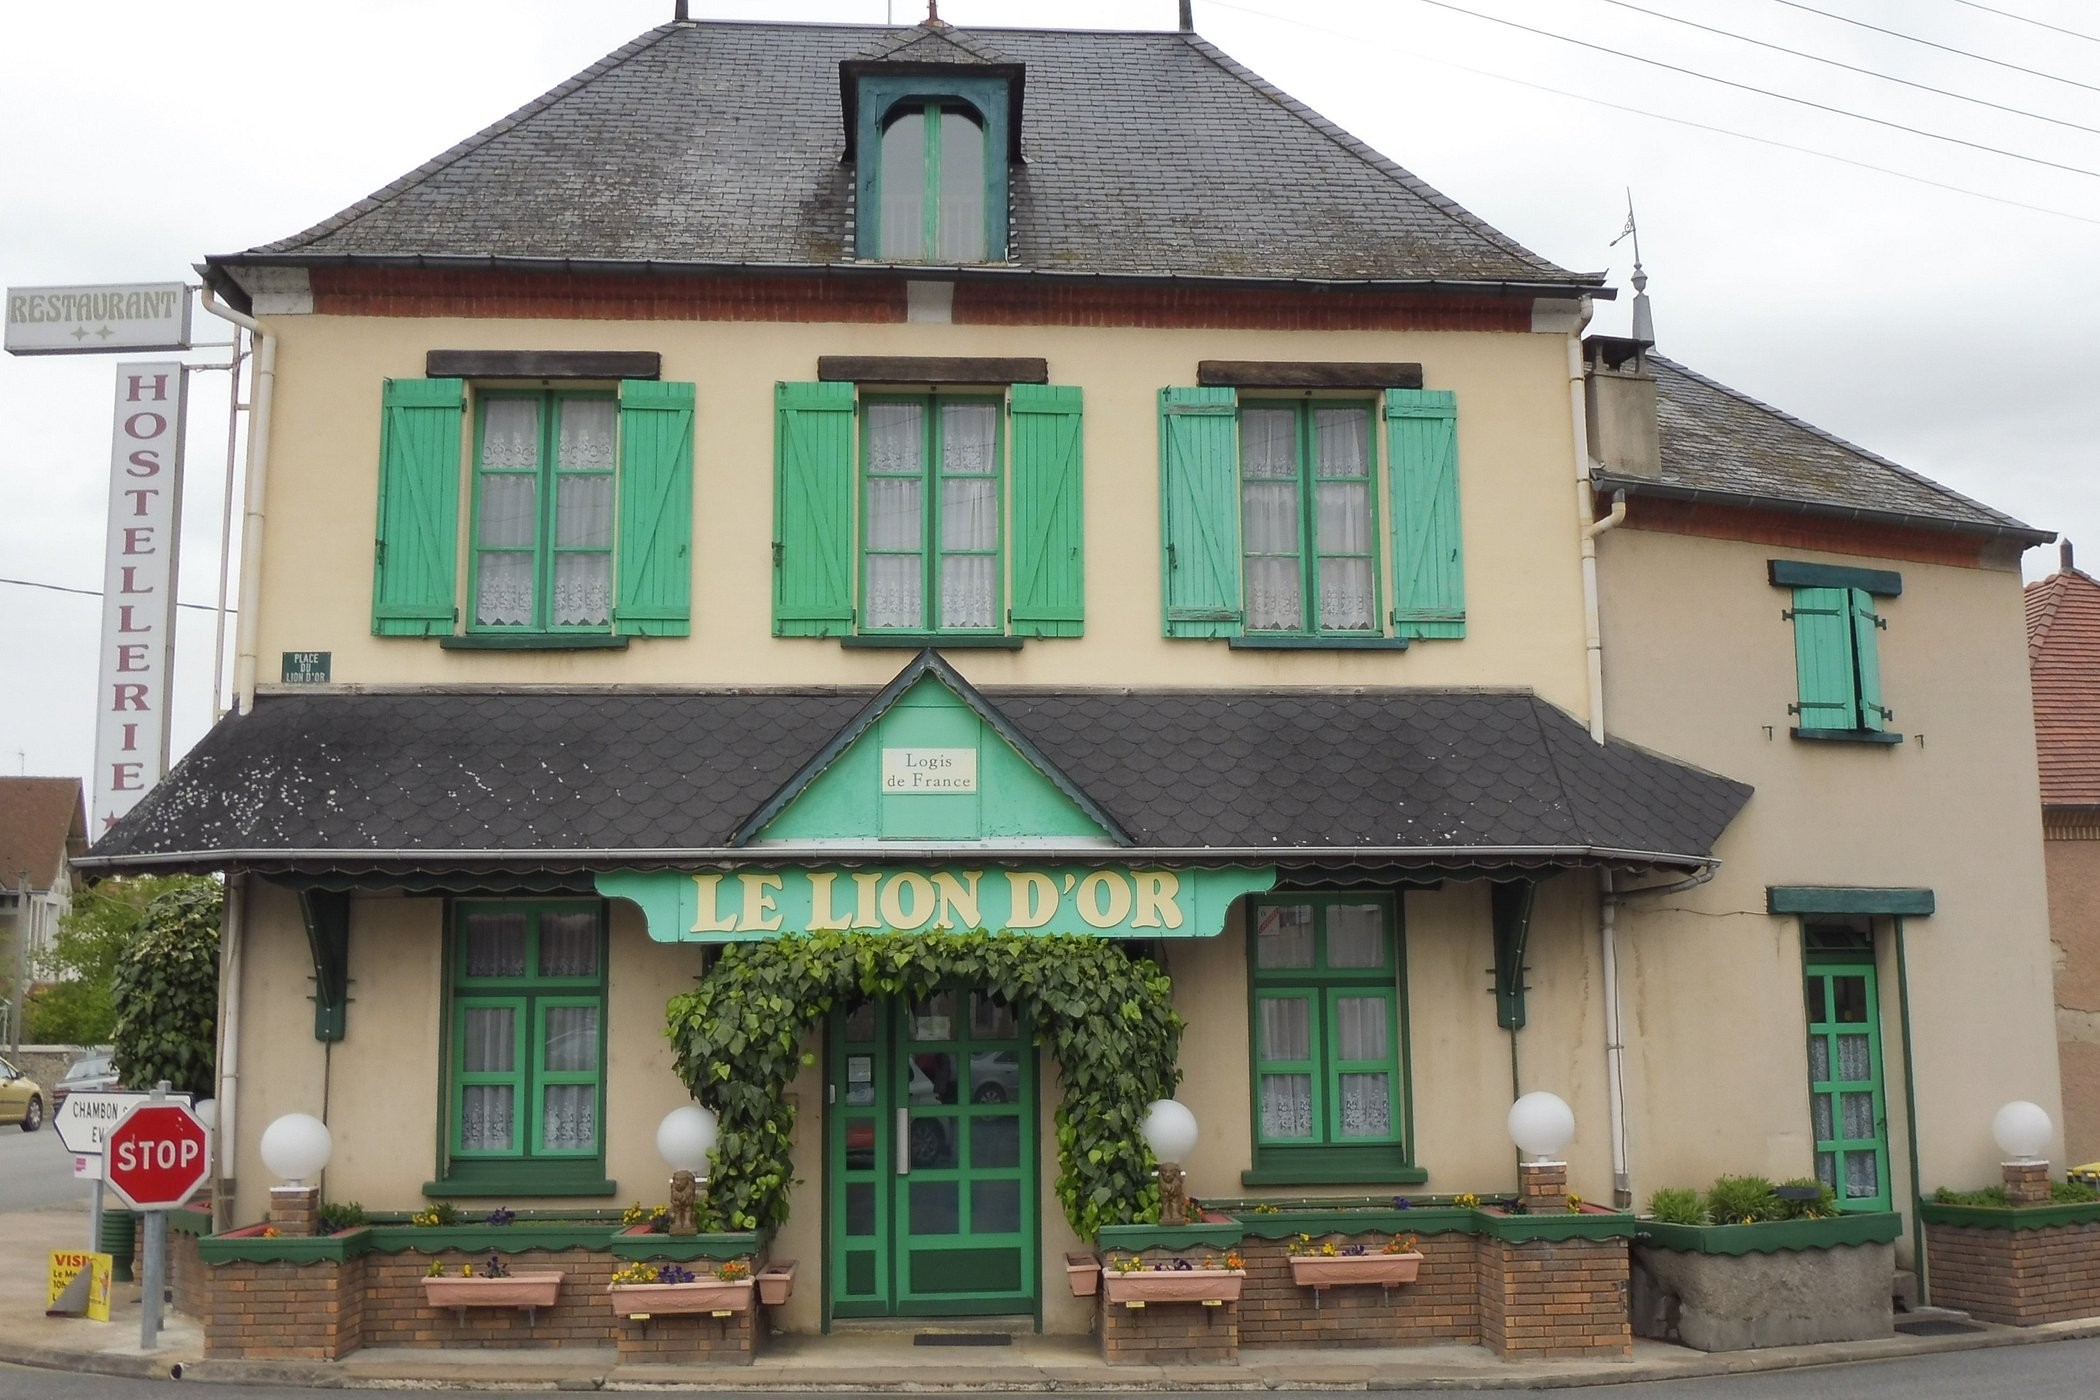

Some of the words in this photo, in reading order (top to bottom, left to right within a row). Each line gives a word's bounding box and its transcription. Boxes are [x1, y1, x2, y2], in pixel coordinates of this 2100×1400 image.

[10, 291, 176, 323] RESTAURANT
[111, 374, 168, 791] HOSTELLERIE
[294, 653, 319, 663] PLACE
[301, 663, 311, 672] DU
[286, 672, 304, 682] LION
[306, 672, 326, 682] D'OR
[906, 753, 952, 770] Logis
[887, 775, 905, 787] de
[912, 772, 970, 787] France
[690, 872, 783, 932] LE
[805, 871, 984, 931] LION
[1004, 870, 1183, 929] D'OR
[73, 1101, 117, 1119] CHAMBON
[117, 1139, 199, 1171] STOP
